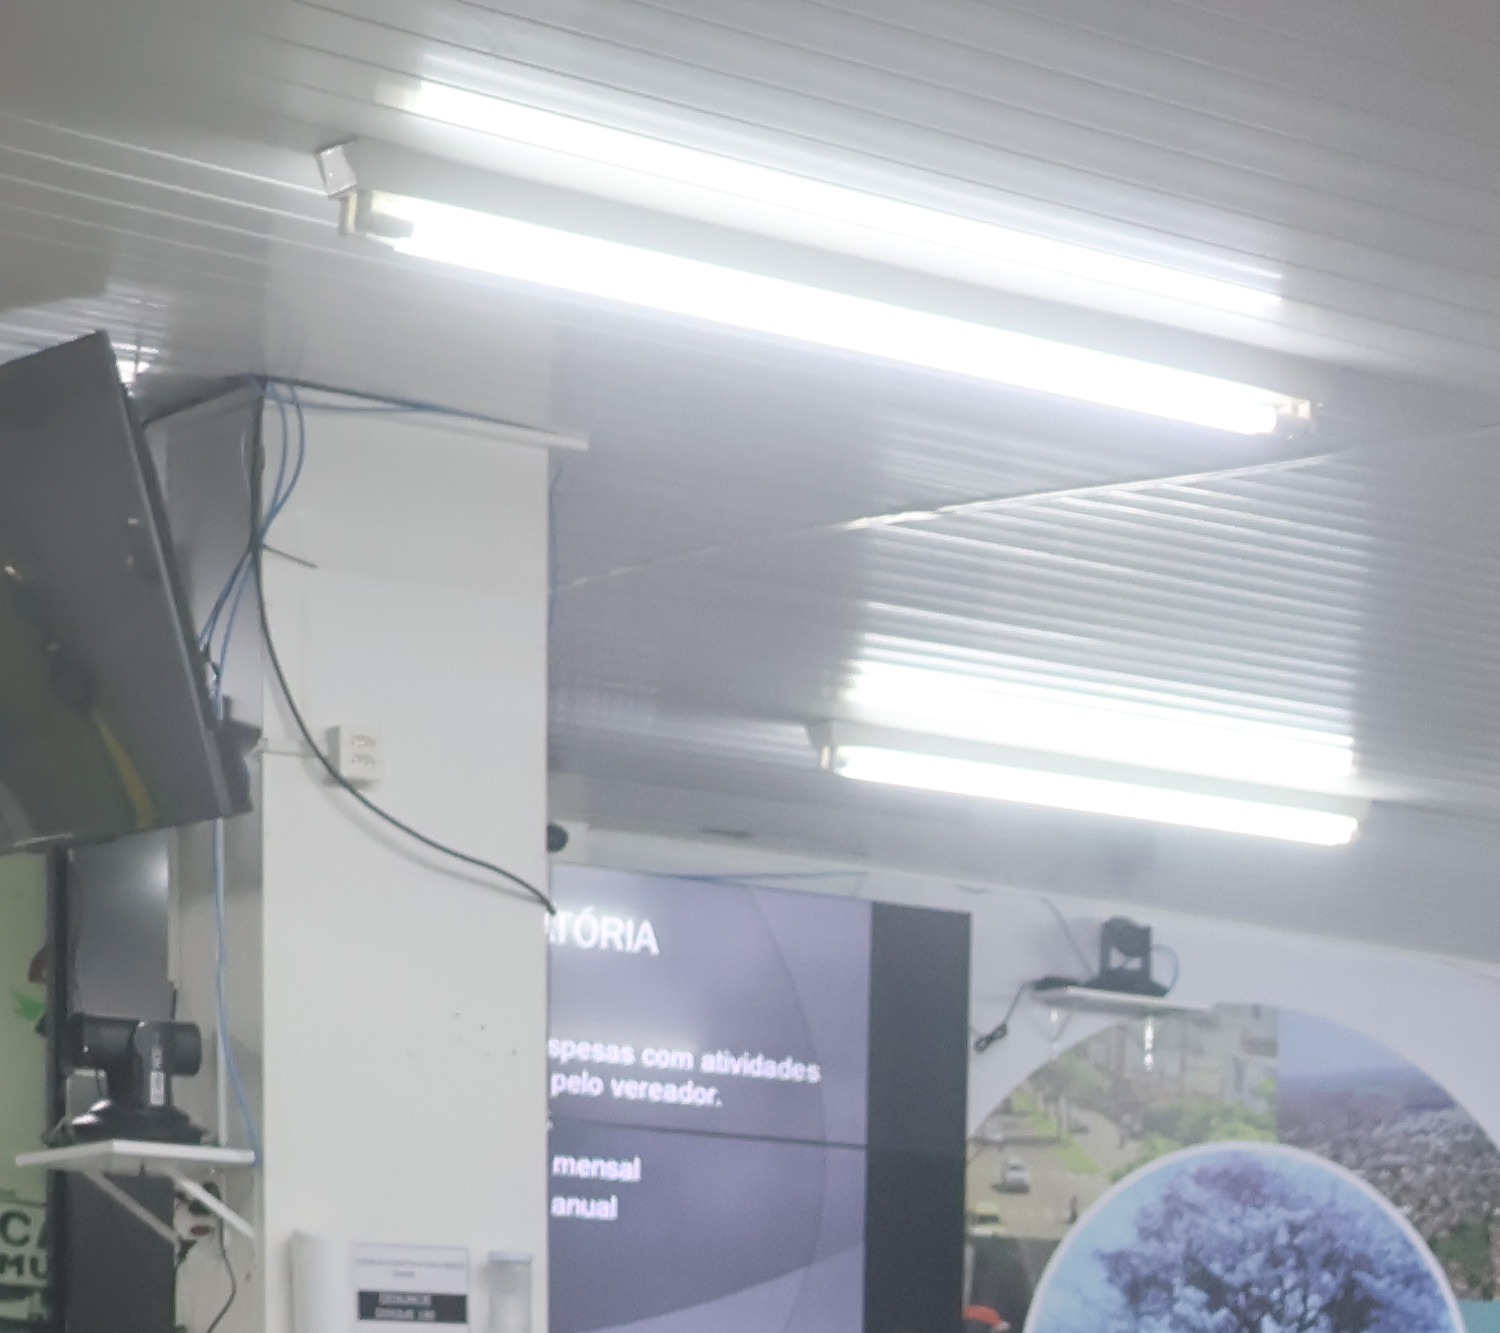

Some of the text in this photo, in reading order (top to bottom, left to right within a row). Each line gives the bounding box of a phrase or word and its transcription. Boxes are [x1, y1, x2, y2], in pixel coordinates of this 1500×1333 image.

[641, 1047, 694, 1071] com
[700, 1050, 822, 1083] atividades
[551, 1070, 723, 1107] pelo vereador.
[553, 1154, 641, 1182] mensal
[551, 1194, 618, 1221] anual
